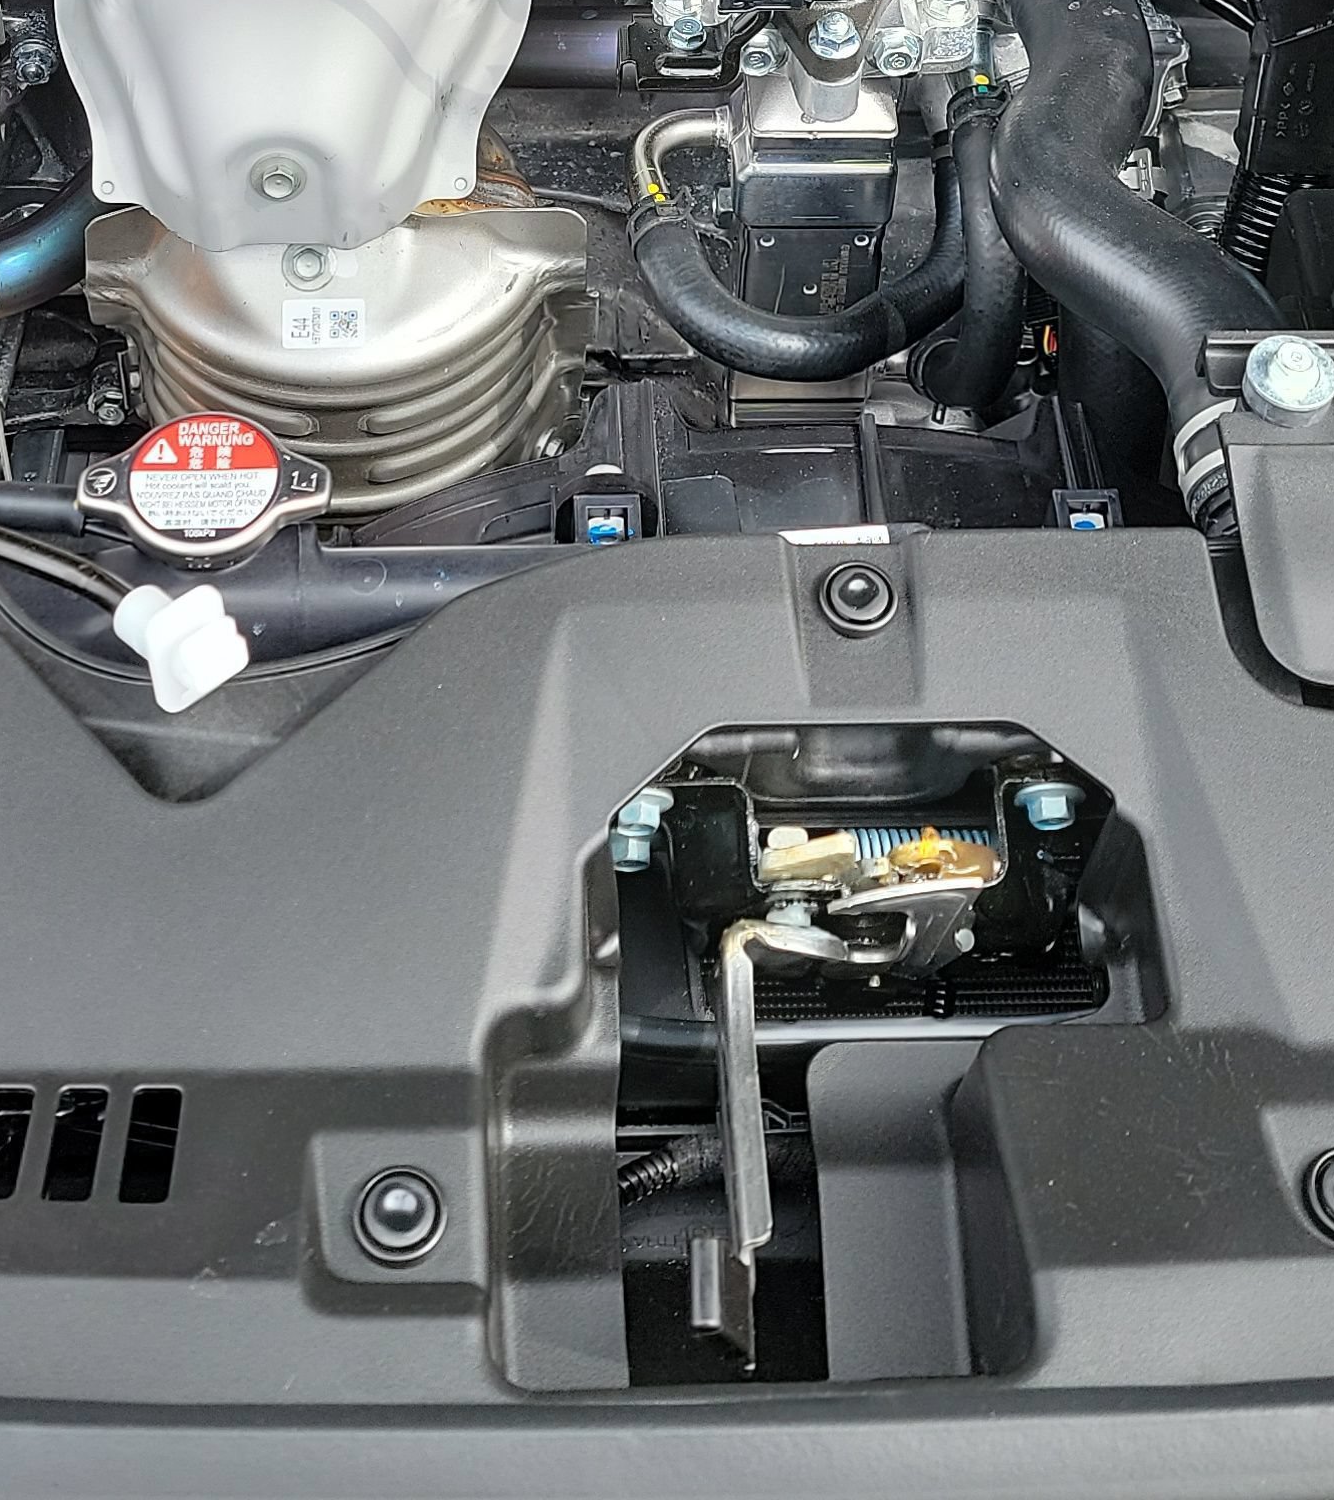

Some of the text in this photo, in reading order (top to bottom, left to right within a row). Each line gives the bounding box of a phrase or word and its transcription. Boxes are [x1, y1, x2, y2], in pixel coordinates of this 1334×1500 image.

[291, 317, 310, 338] E44
[178, 422, 240, 435] DANGER
[178, 433, 256, 446] WARNUNG
[146, 473, 177, 481] NEVER
[180, 473, 208, 481] OPEN
[209, 473, 238, 481] WHEN
[136, 489, 266, 499] N'OUVREZ PAS QUAND CHAUD
[208, 500, 233, 508] MOTOR
